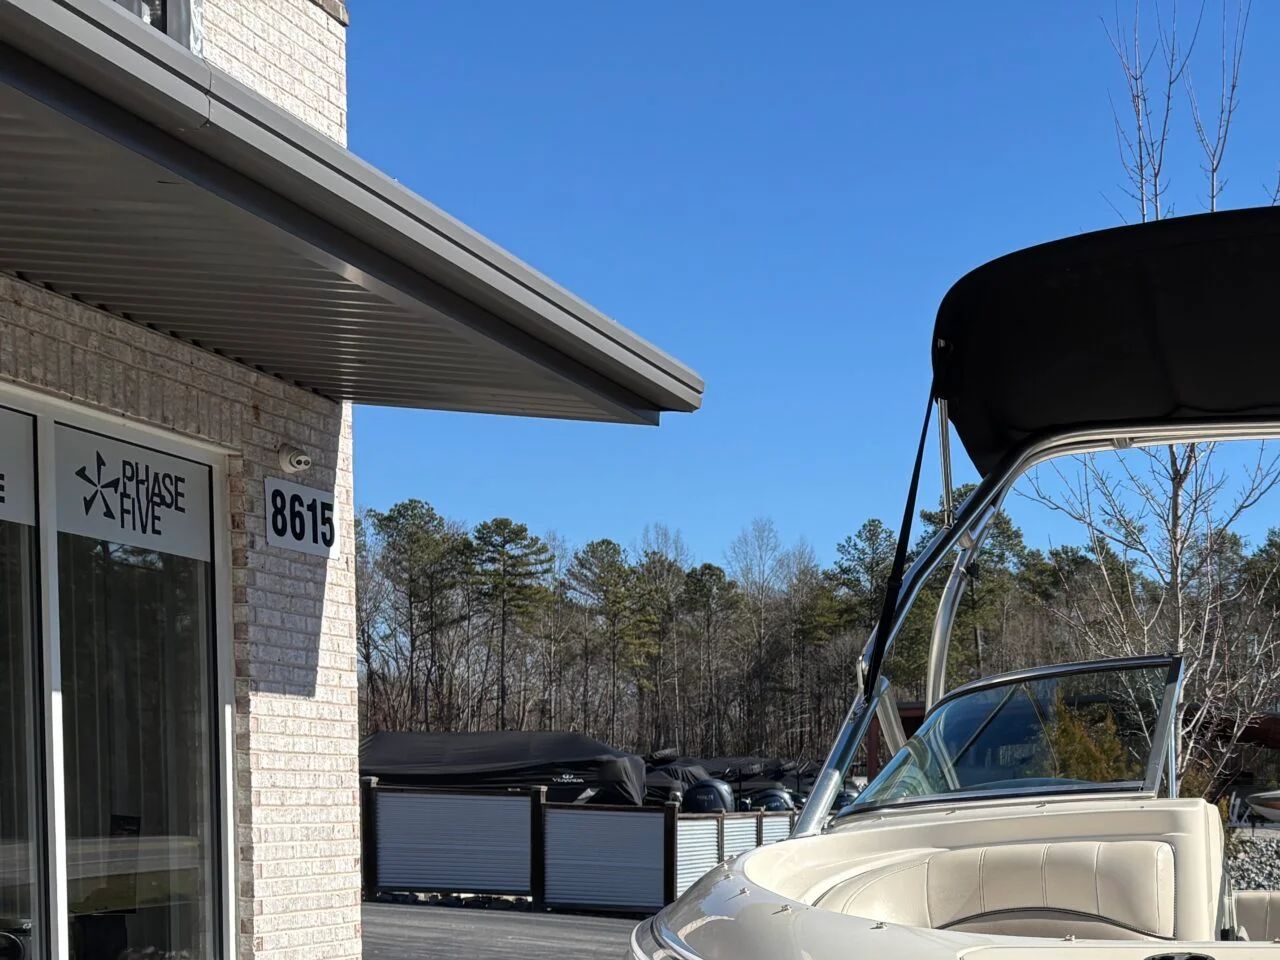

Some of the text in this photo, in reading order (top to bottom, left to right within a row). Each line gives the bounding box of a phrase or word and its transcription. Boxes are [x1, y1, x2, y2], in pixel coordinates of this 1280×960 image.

[122, 460, 186, 513] PHASE
[120, 492, 162, 535] FIVE
[271, 488, 335, 548] 8615
